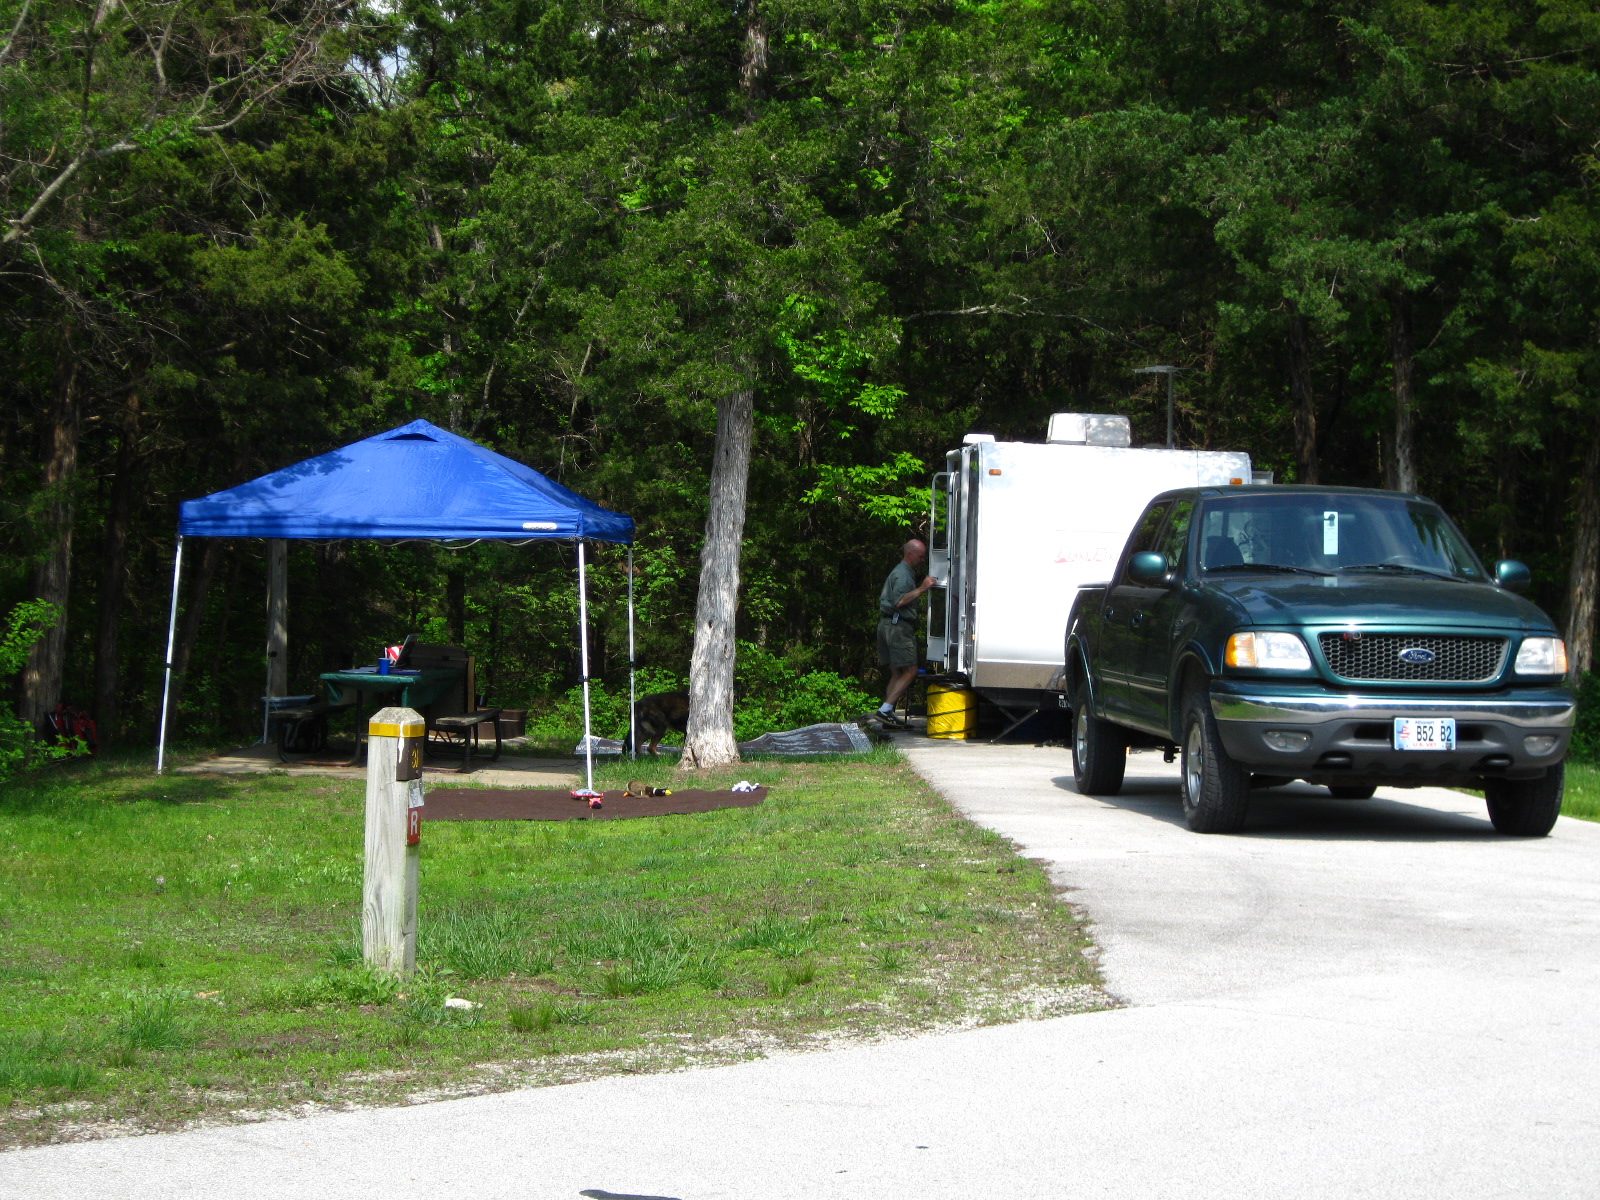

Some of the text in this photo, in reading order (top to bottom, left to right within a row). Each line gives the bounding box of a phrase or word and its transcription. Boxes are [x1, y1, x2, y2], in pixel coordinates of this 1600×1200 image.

[1417, 725, 1452, 741] B52 B2
[410, 810, 418, 835] R
